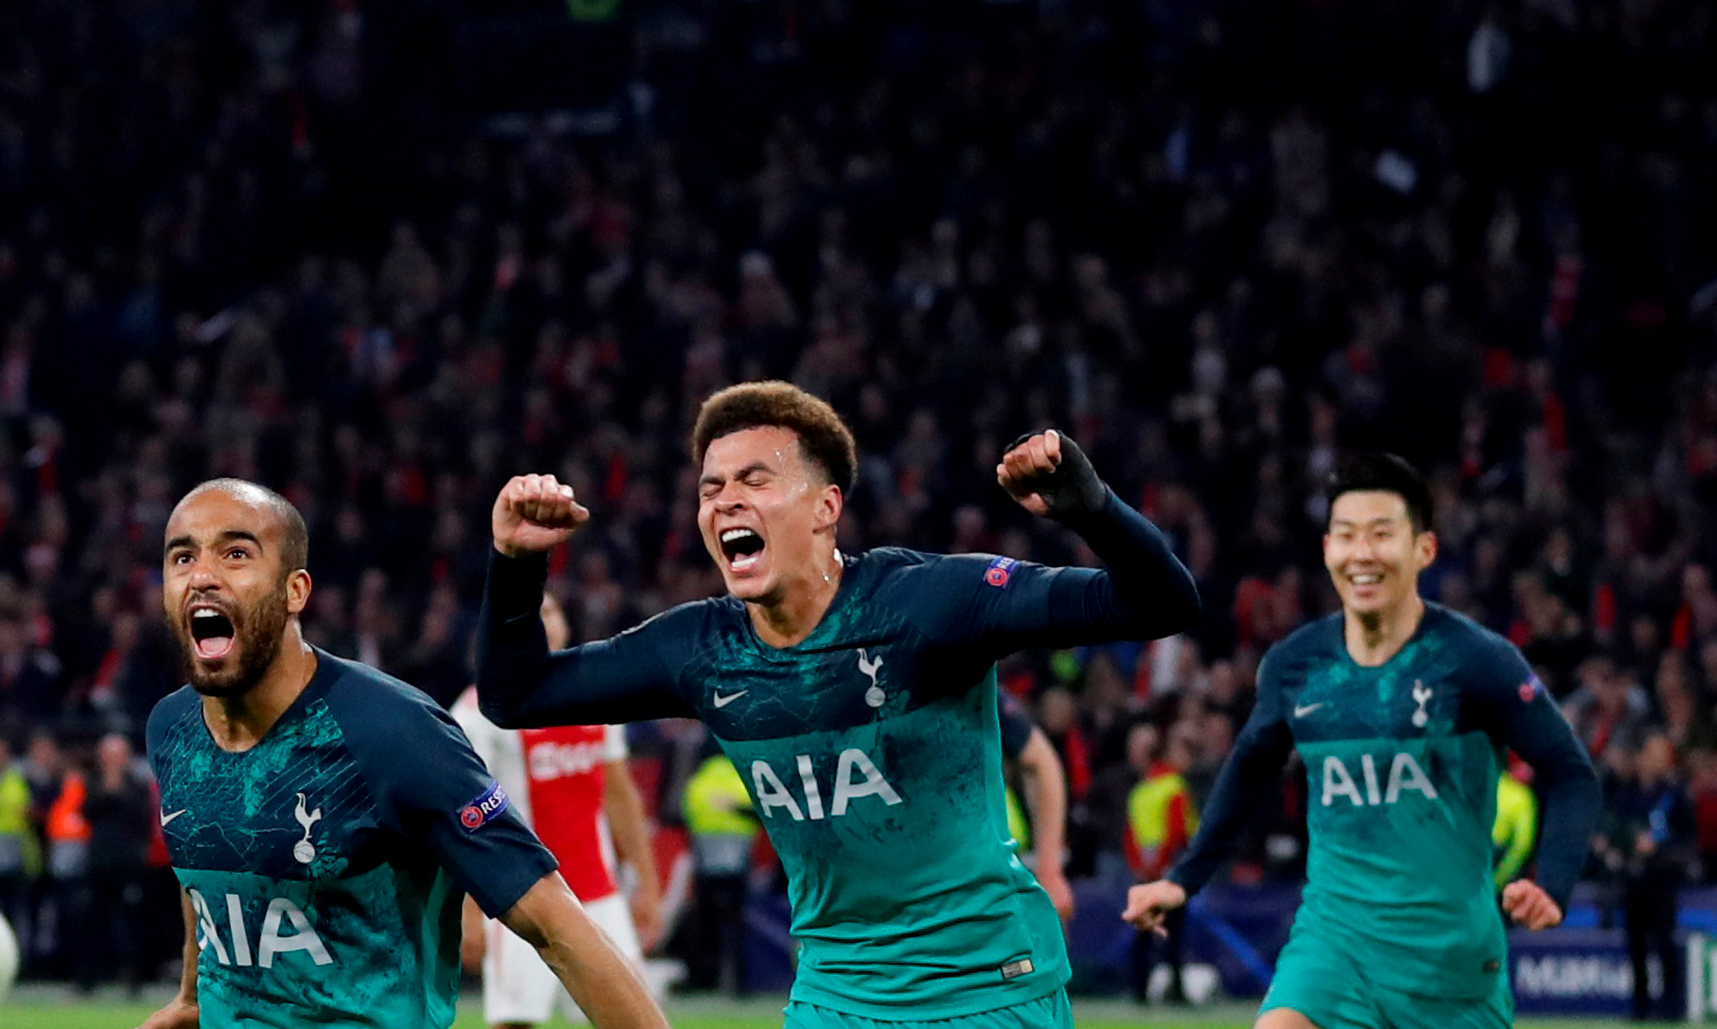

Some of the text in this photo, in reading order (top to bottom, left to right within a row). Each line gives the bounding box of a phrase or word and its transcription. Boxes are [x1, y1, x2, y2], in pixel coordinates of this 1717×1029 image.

[751, 749, 903, 821] AIA
[1321, 752, 1439, 806] AIA
[189, 888, 333, 969] AIA
